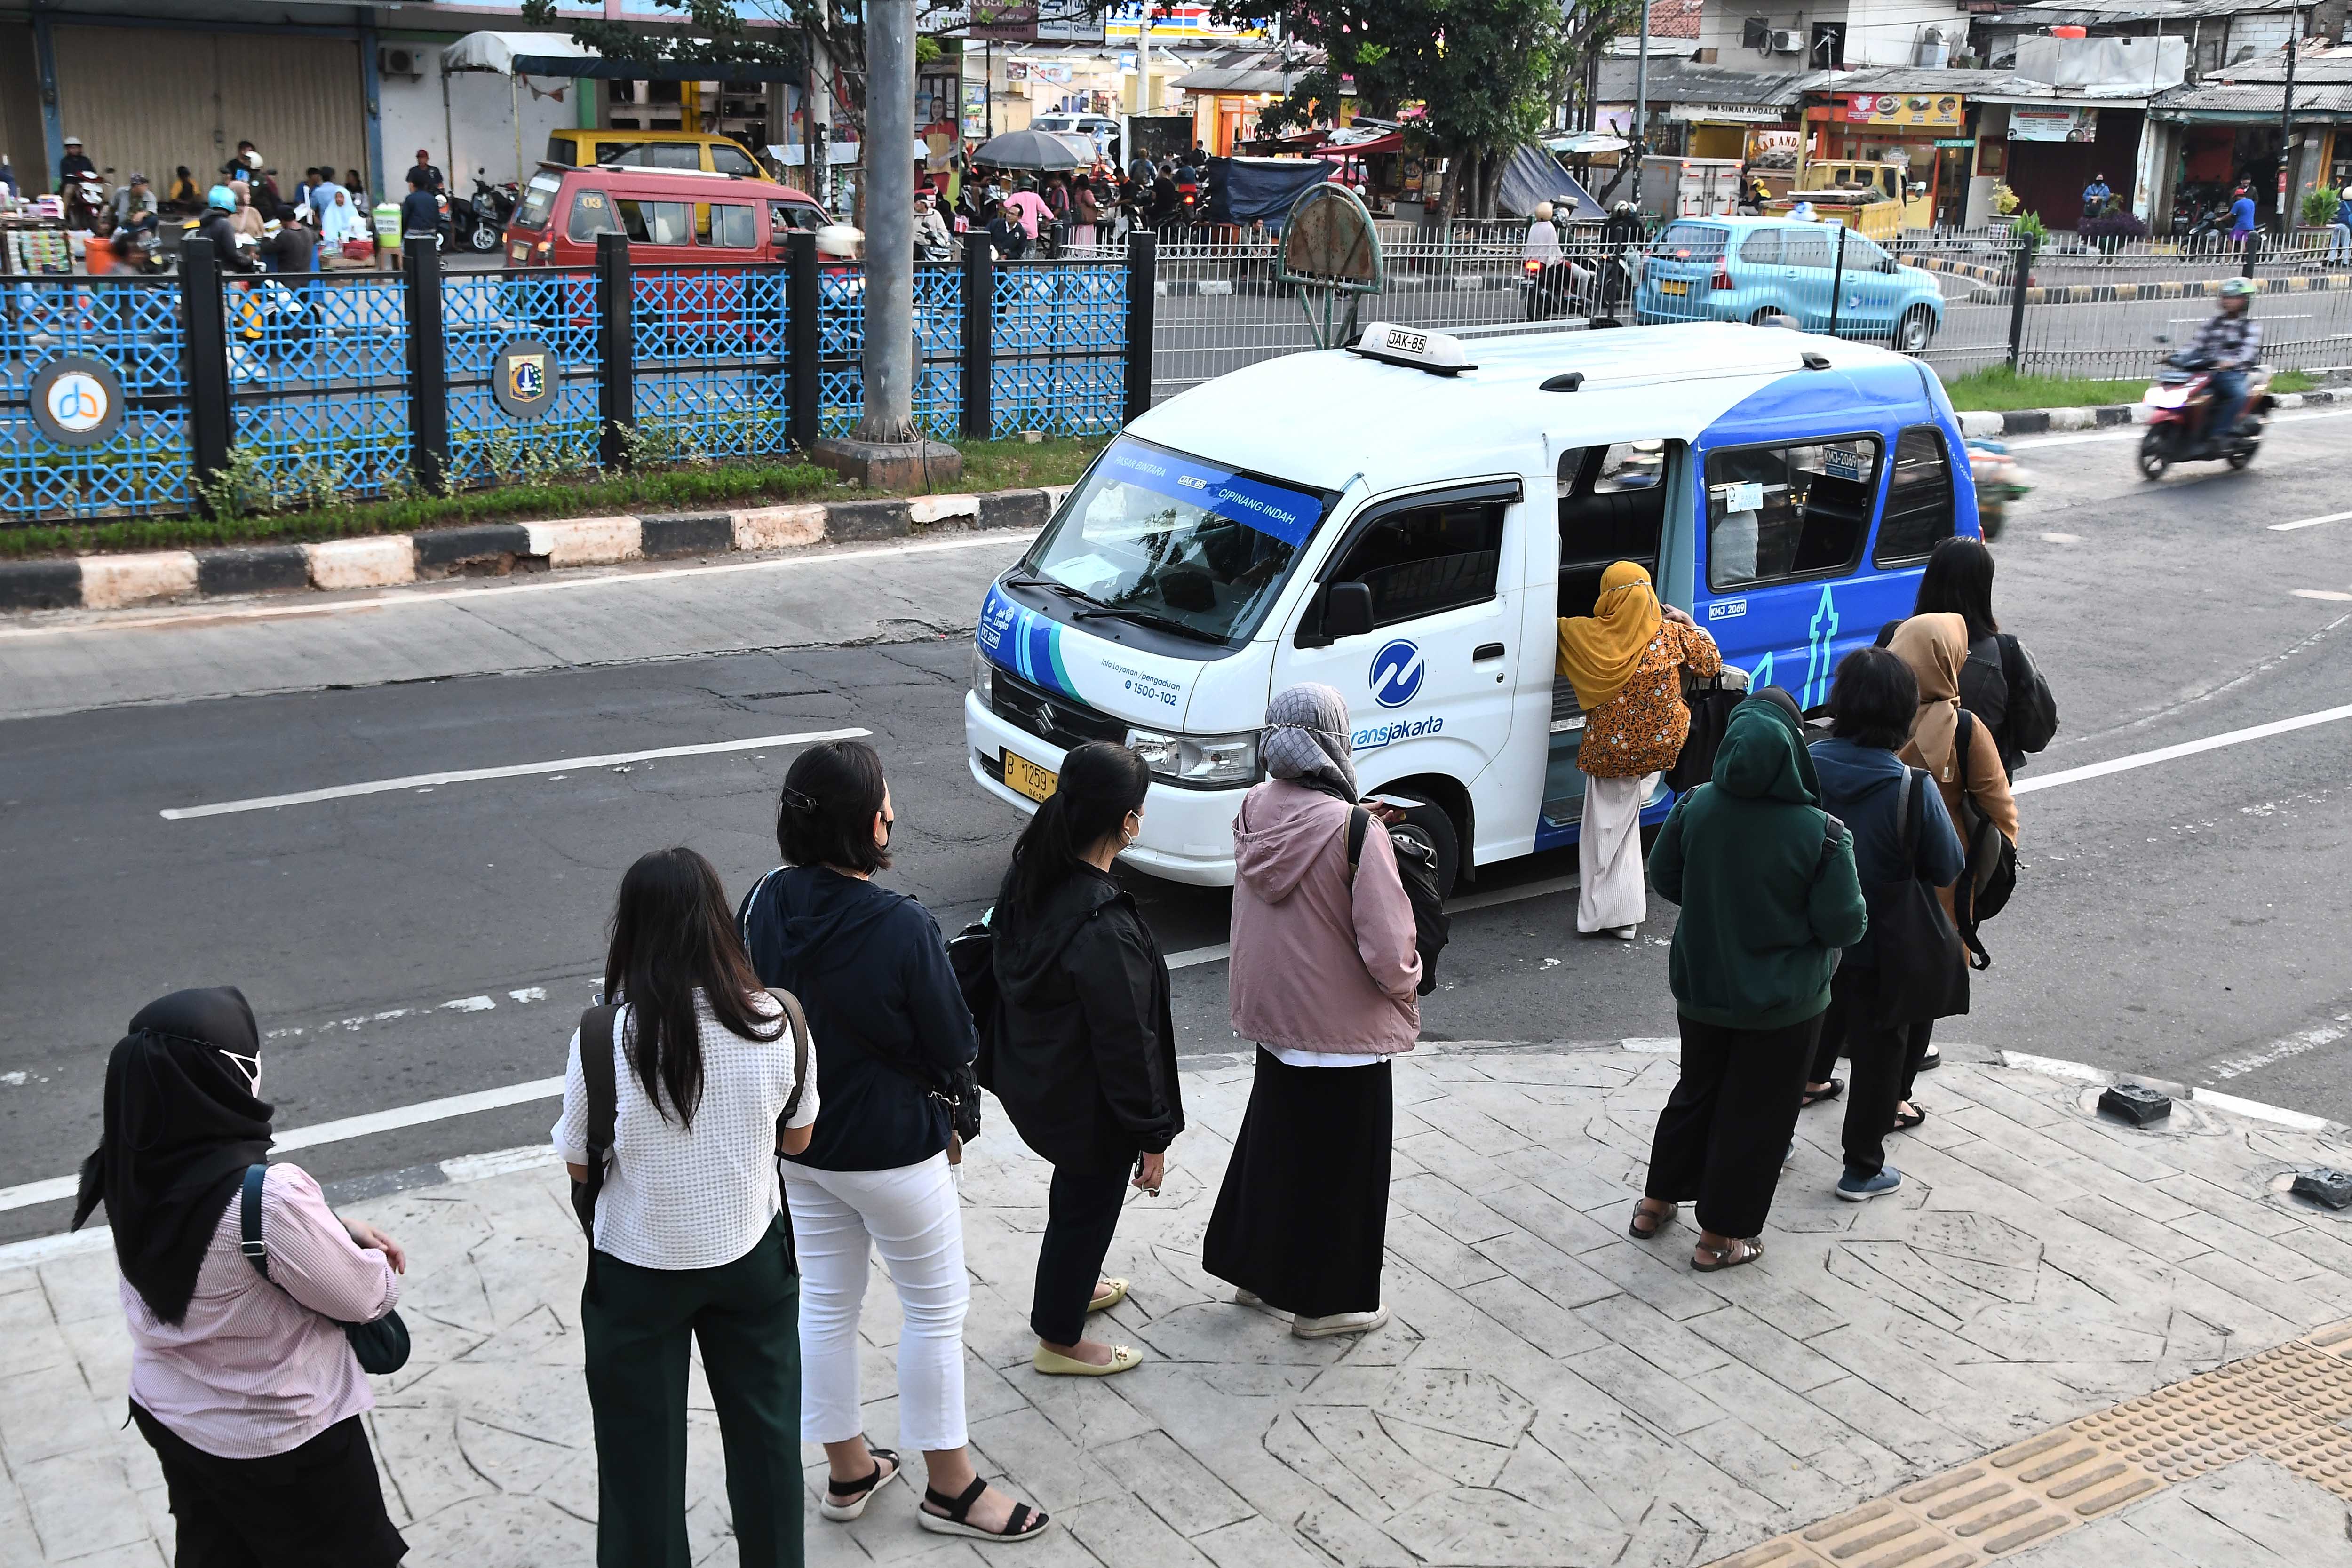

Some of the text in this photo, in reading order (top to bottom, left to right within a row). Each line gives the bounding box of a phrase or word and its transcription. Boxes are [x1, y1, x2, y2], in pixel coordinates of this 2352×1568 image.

[1073, 25, 1101, 34] Quantum
[1720, 105, 1745, 114] SINAR
[582, 197, 602, 209] 03
[1389, 333, 1425, 350] JAK-85
[1825, 449, 1856, 468] KMJ-2069
[1135, 461, 1167, 478] BINTARA
[1179, 476, 1205, 488] JAK 85
[1218, 488, 1297, 525] CIPINANG INDAH
[1710, 603, 1745, 617] KMJ 2069
[993, 616, 1009, 630] Lingko
[988, 631, 999, 645] 2069
[1101, 658, 1112, 668] Info
[1112, 662, 1138, 677] Layanan
[1134, 683, 1177, 706] 1500-102
[1350, 716, 1444, 751] ransjakarta
[1007, 755, 1047, 791] B 1259
